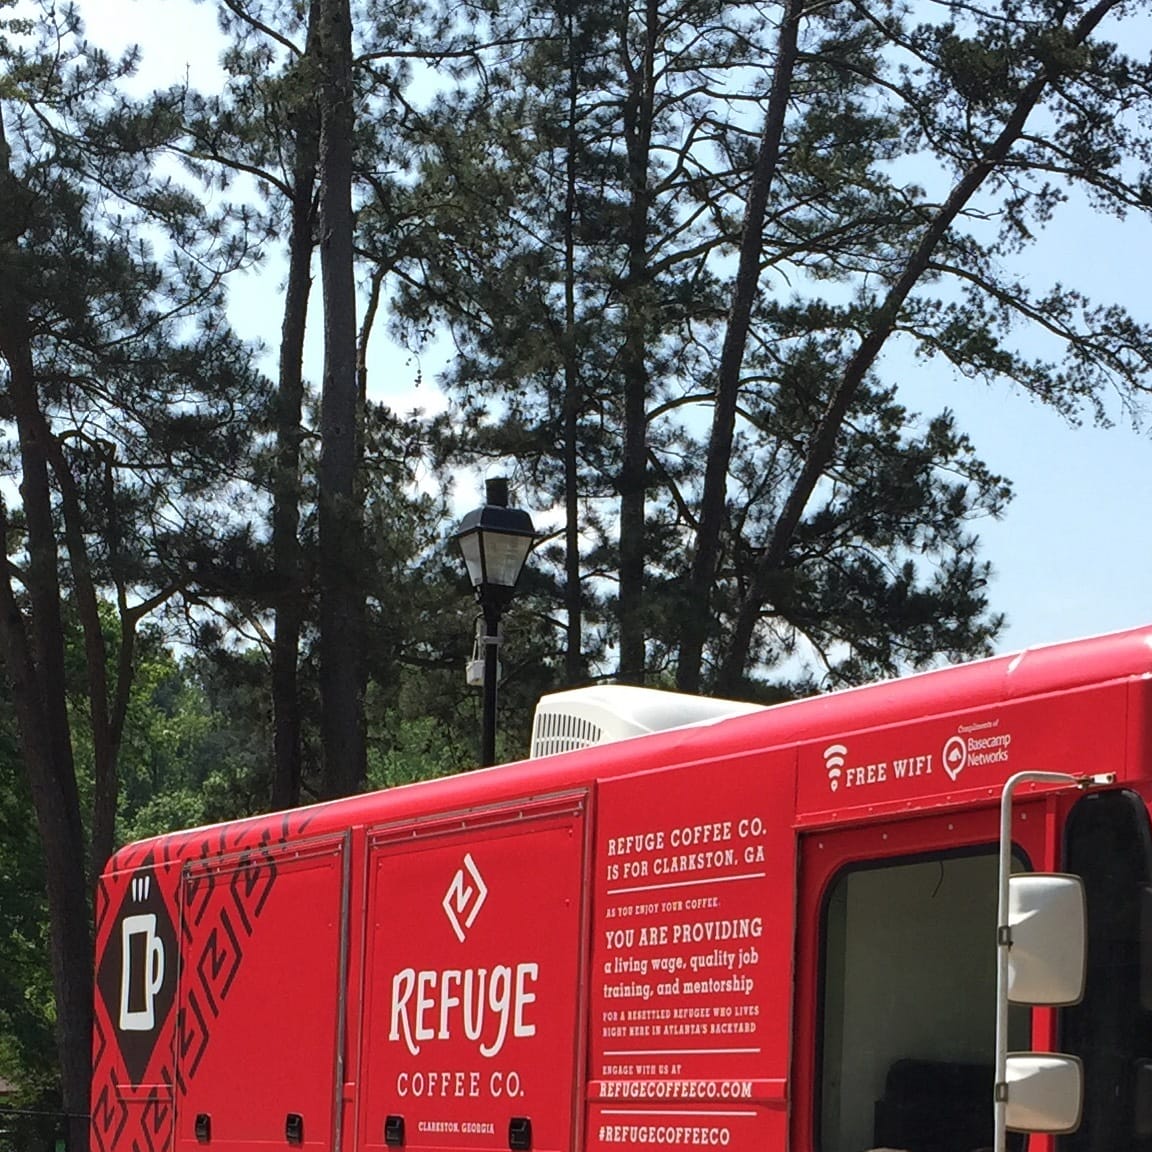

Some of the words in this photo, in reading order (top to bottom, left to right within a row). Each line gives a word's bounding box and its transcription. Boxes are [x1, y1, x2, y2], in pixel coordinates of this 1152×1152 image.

[967, 734, 1011, 751] Basecamp
[967, 748, 1008, 767] Networks
[846, 763, 887, 787] FREE
[893, 755, 933, 779] WIFI
[608, 832, 664, 856] REFUGE
[670, 822, 731, 847] COFFEE
[738, 818, 767, 838] CO.
[607, 865, 619, 880] IS
[624, 861, 648, 878] FOR
[744, 846, 765, 863] GA
[606, 908, 616, 918] AS
[618, 907, 632, 917] YOU
[635, 903, 659, 915] ENJOY
[661, 901, 683, 913] YOUR
[605, 929, 634, 949] YOU
[638, 926, 668, 947] ARE
[673, 918, 763, 943] PROVIDING
[604, 962, 612, 974] a
[614, 957, 648, 975] living
[651, 956, 687, 973] wage,
[690, 949, 736, 972] quality
[738, 946, 759, 968] job
[603, 981, 654, 1000] training,
[657, 978, 680, 995] and
[683, 975, 754, 995] mentorship
[603, 1011, 618, 1022] FOR
[620, 1011, 626, 1021] A
[627, 1008, 671, 1021] RESETTLED
[673, 1008, 710, 1019] REFUGEE
[713, 1006, 733, 1017] WHO
[735, 1005, 760, 1017] LIVES
[603, 1027, 627, 1037] RIGHT
[629, 1026, 650, 1036] HERE
[652, 1025, 661, 1036] IN
[710, 1022, 756, 1034] BACKYARD
[602, 1065, 634, 1075] ENGAGE
[635, 1065, 656, 1075] WITH
[658, 1065, 669, 1075] US
[671, 1064, 682, 1075] AT
[397, 1071, 480, 1096] COFFEE
[490, 1071, 525, 1097] CO.
[599, 1081, 752, 1098] REFUGECOFFEECO.COM
[461, 1122, 494, 1134] GEORGIA
[599, 1126, 730, 1145] #REFUGECOFFEECO
